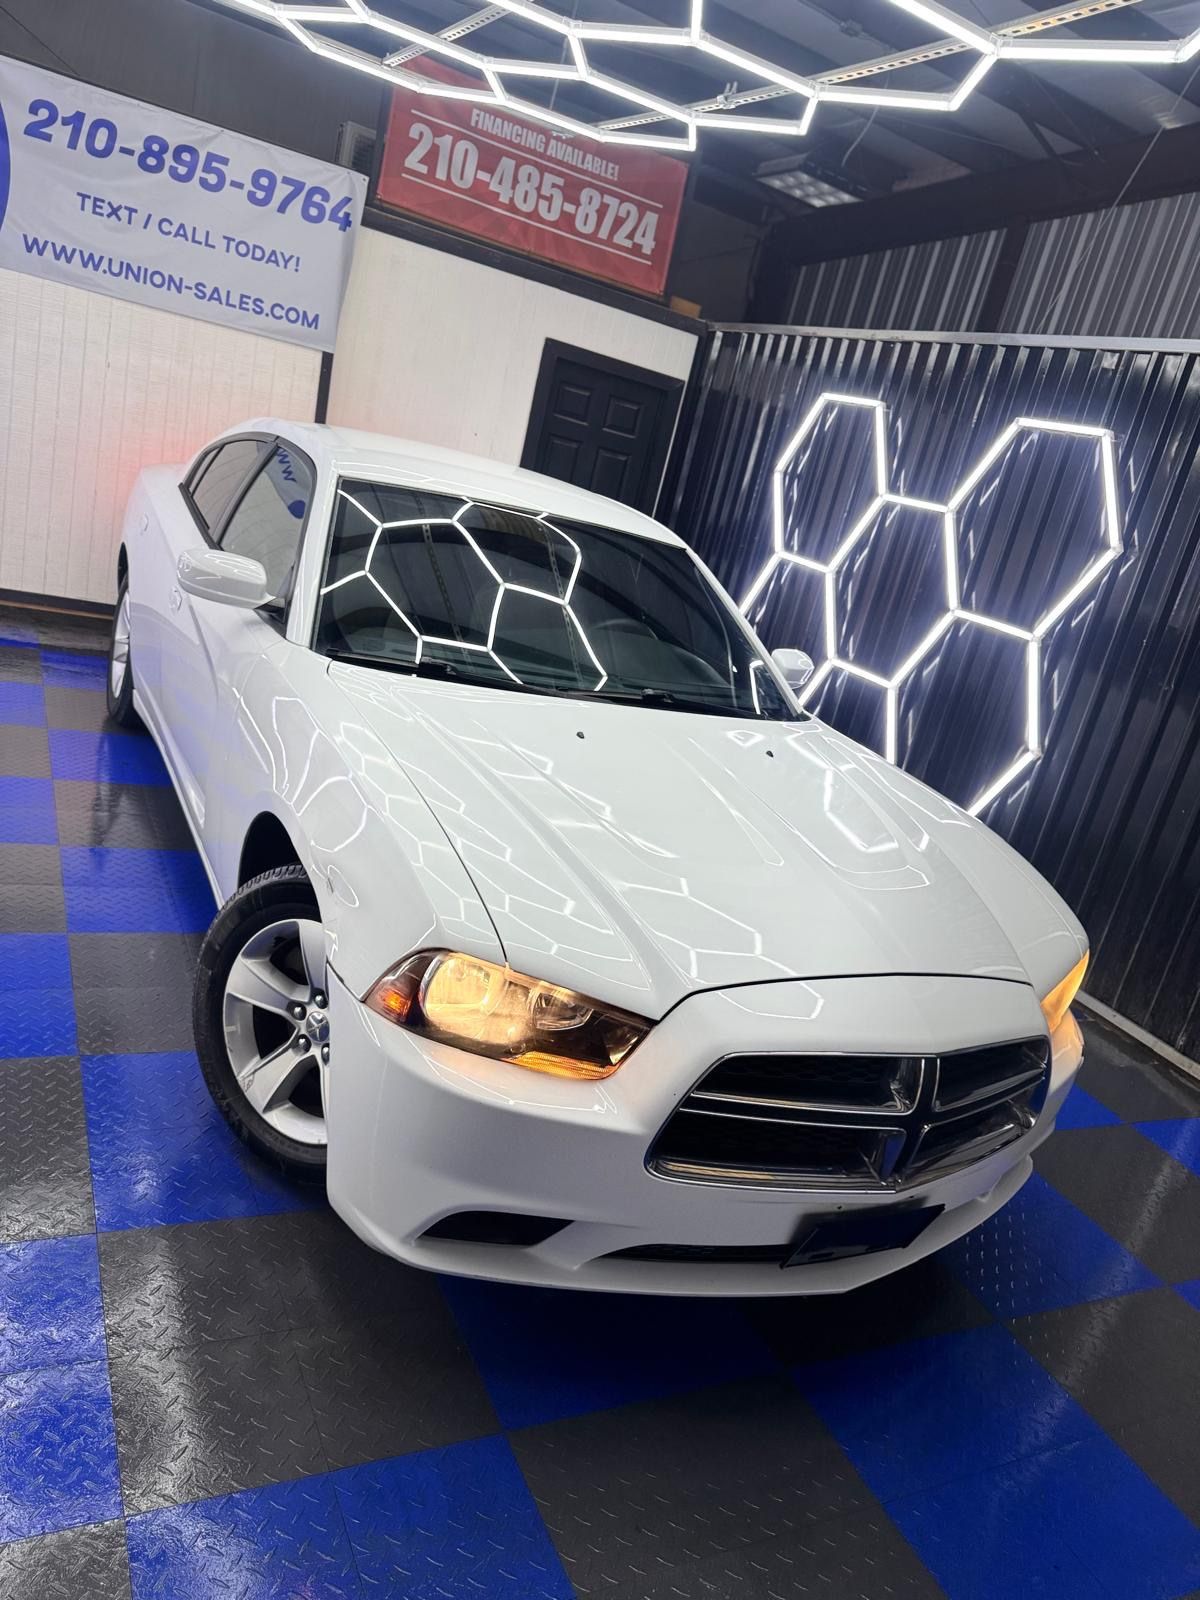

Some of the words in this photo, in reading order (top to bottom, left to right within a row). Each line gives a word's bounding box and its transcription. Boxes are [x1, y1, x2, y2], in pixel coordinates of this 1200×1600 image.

[24, 98, 353, 232] 210-895-9764
[404, 123, 659, 255] 210-485-8724
[470, 108, 546, 151] FINANCING
[547, 139, 620, 181] AVAILABLE!
[76, 191, 138, 225] TEXT
[142, 213, 153, 230] /
[157, 217, 216, 249] CALL
[222, 235, 301, 272] TODAY!
[22, 234, 320, 330] WWW.UNION-SALES.COM
